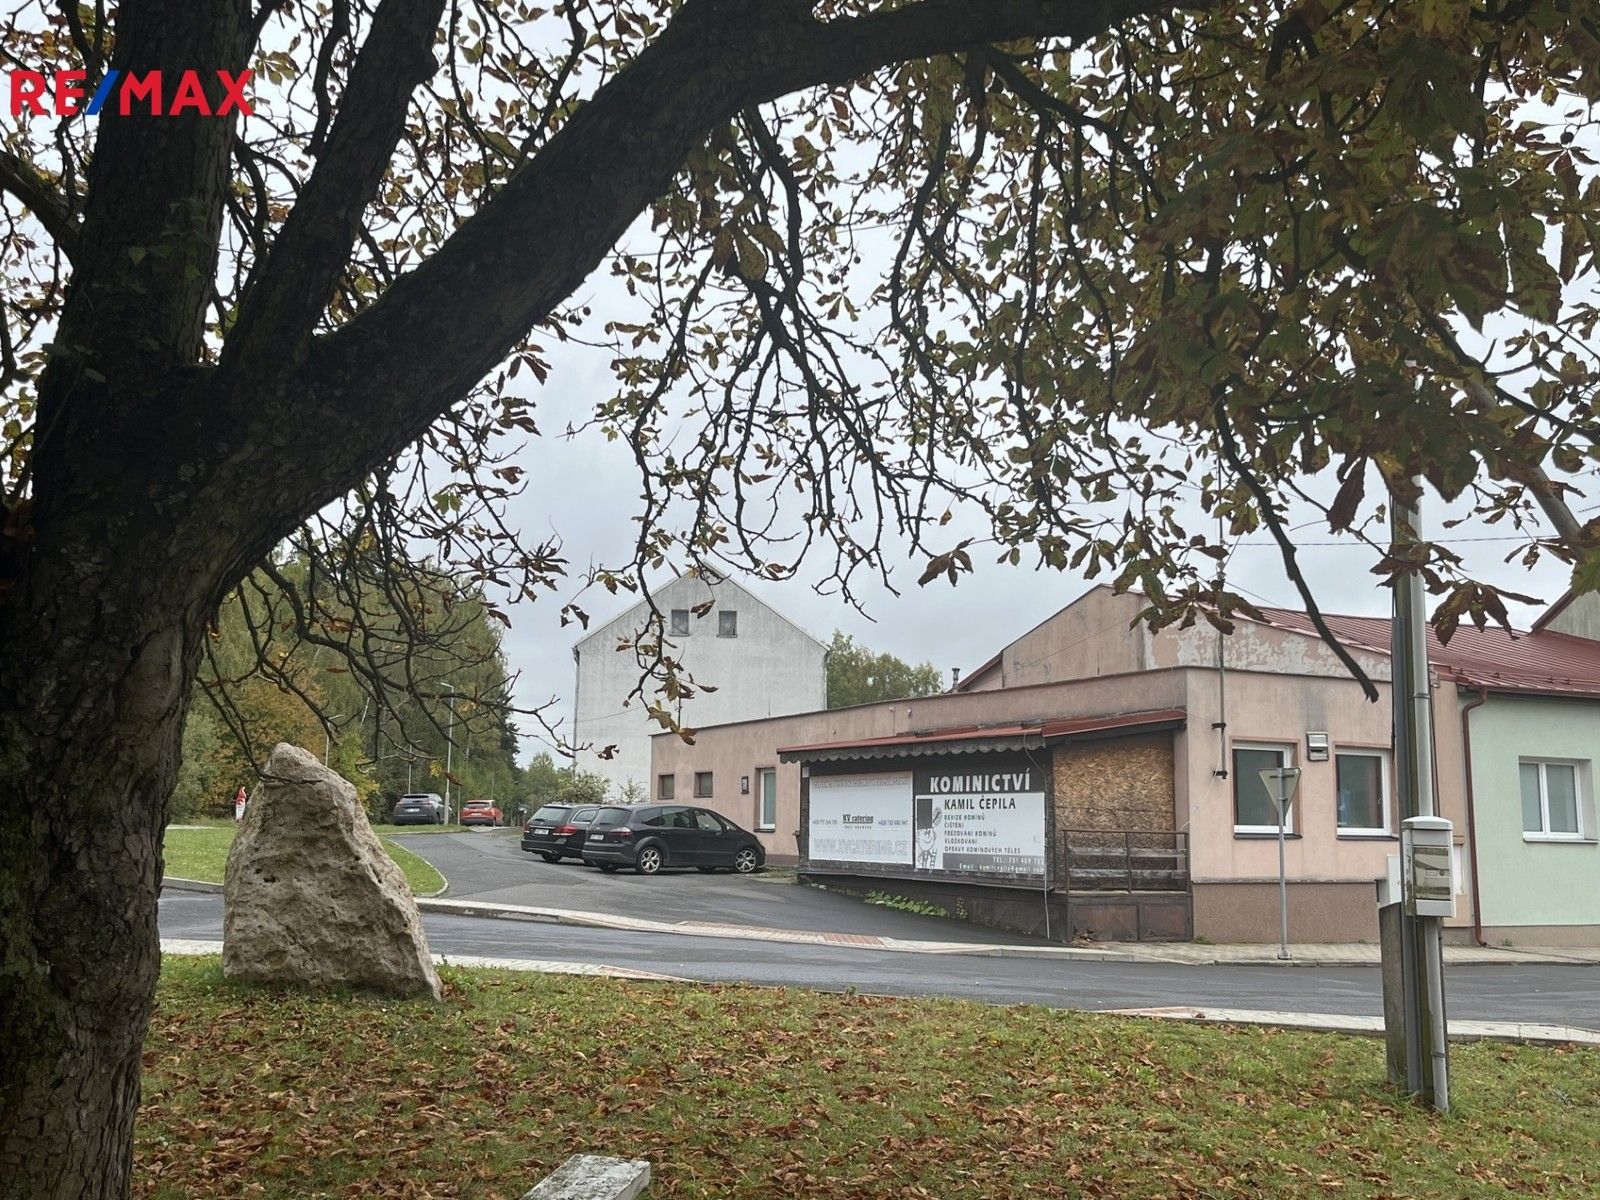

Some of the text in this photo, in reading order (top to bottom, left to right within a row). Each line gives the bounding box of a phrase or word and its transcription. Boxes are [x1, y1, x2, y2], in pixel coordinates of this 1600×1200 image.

[930, 768, 1030, 793] KOMINICTVÍ
[944, 796, 1016, 810] KAMIL ČEPILA
[842, 814, 851, 822] KV
[851, 814, 874, 823] catering
